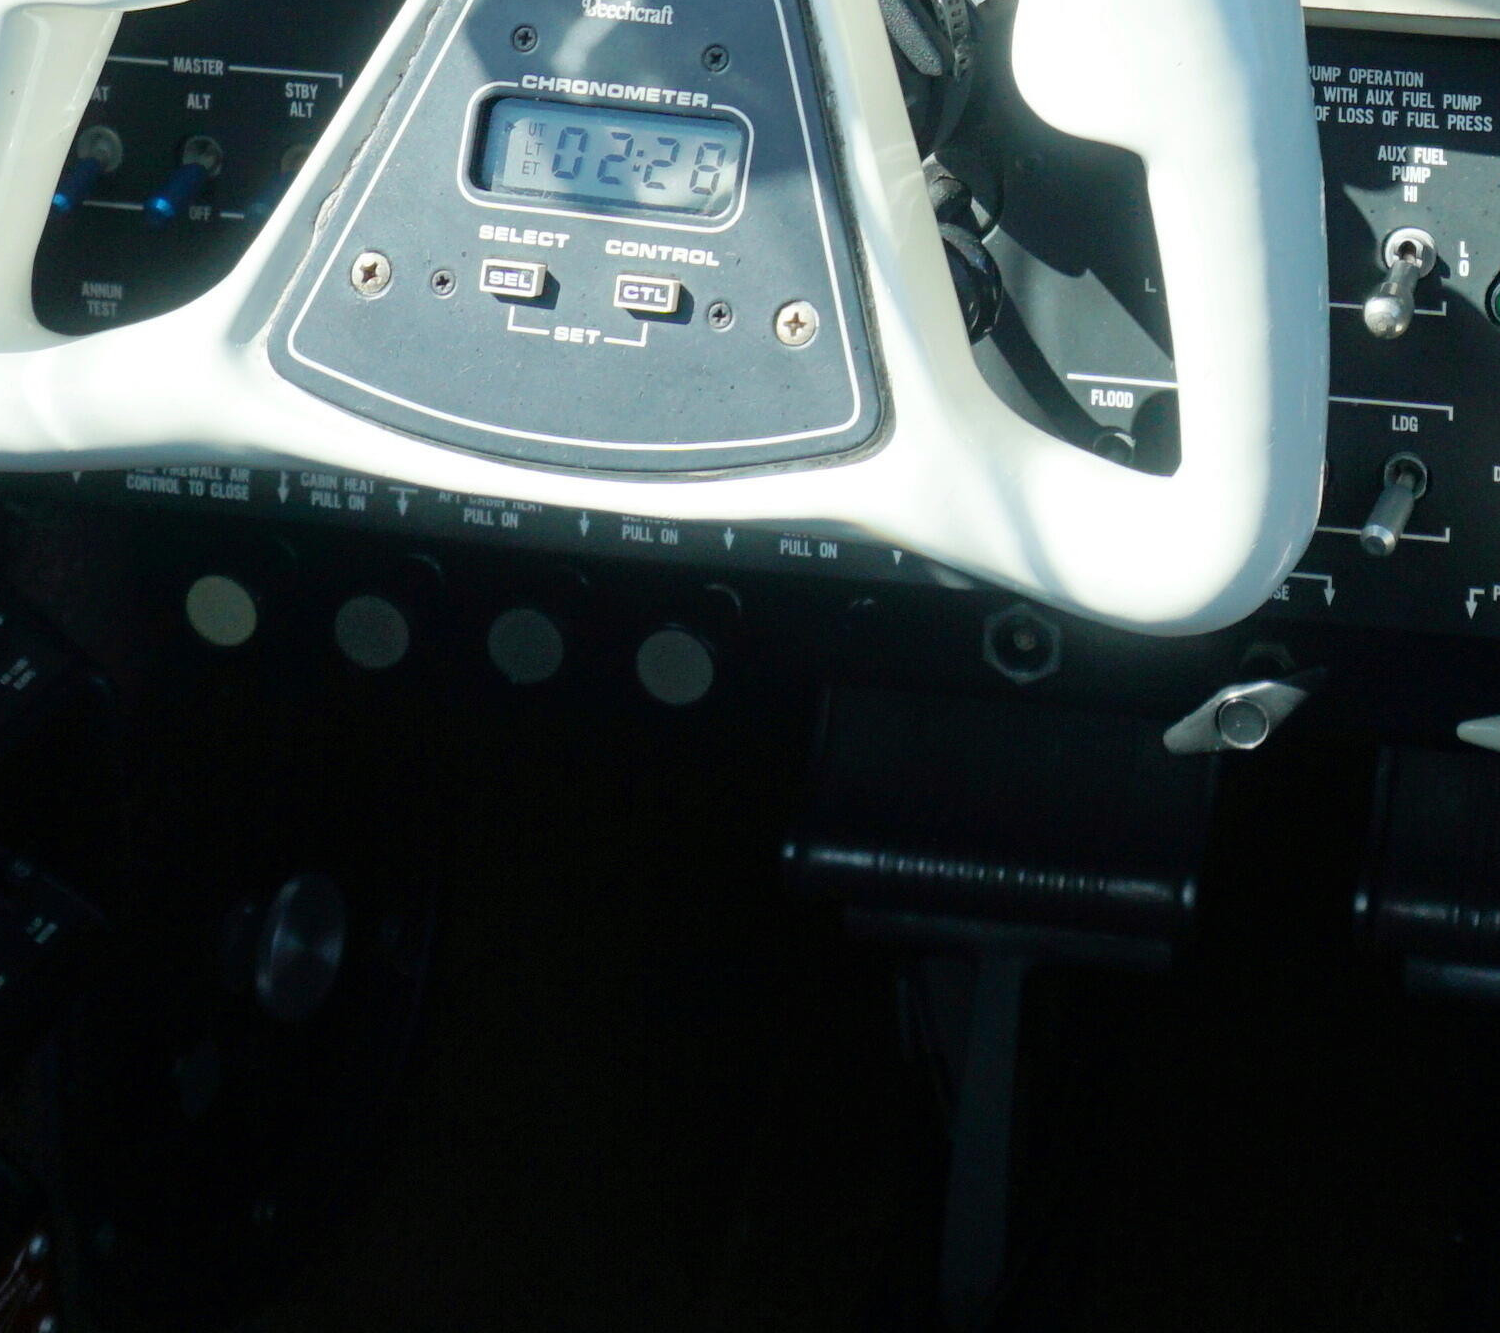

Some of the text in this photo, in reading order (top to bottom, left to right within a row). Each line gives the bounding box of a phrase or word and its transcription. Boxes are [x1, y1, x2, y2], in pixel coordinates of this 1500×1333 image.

[174, 57, 223, 75] MASTER
[522, 75, 708, 107] CHRONOMETER
[1378, 145, 1447, 165] AUX FUEL
[1392, 165, 1430, 183] PUMP
[1404, 185, 1417, 202] HI
[479, 225, 570, 248] SELECT
[605, 239, 719, 266] CONTROL
[554, 327, 600, 344] SET
[1392, 415, 1418, 432] LDG
